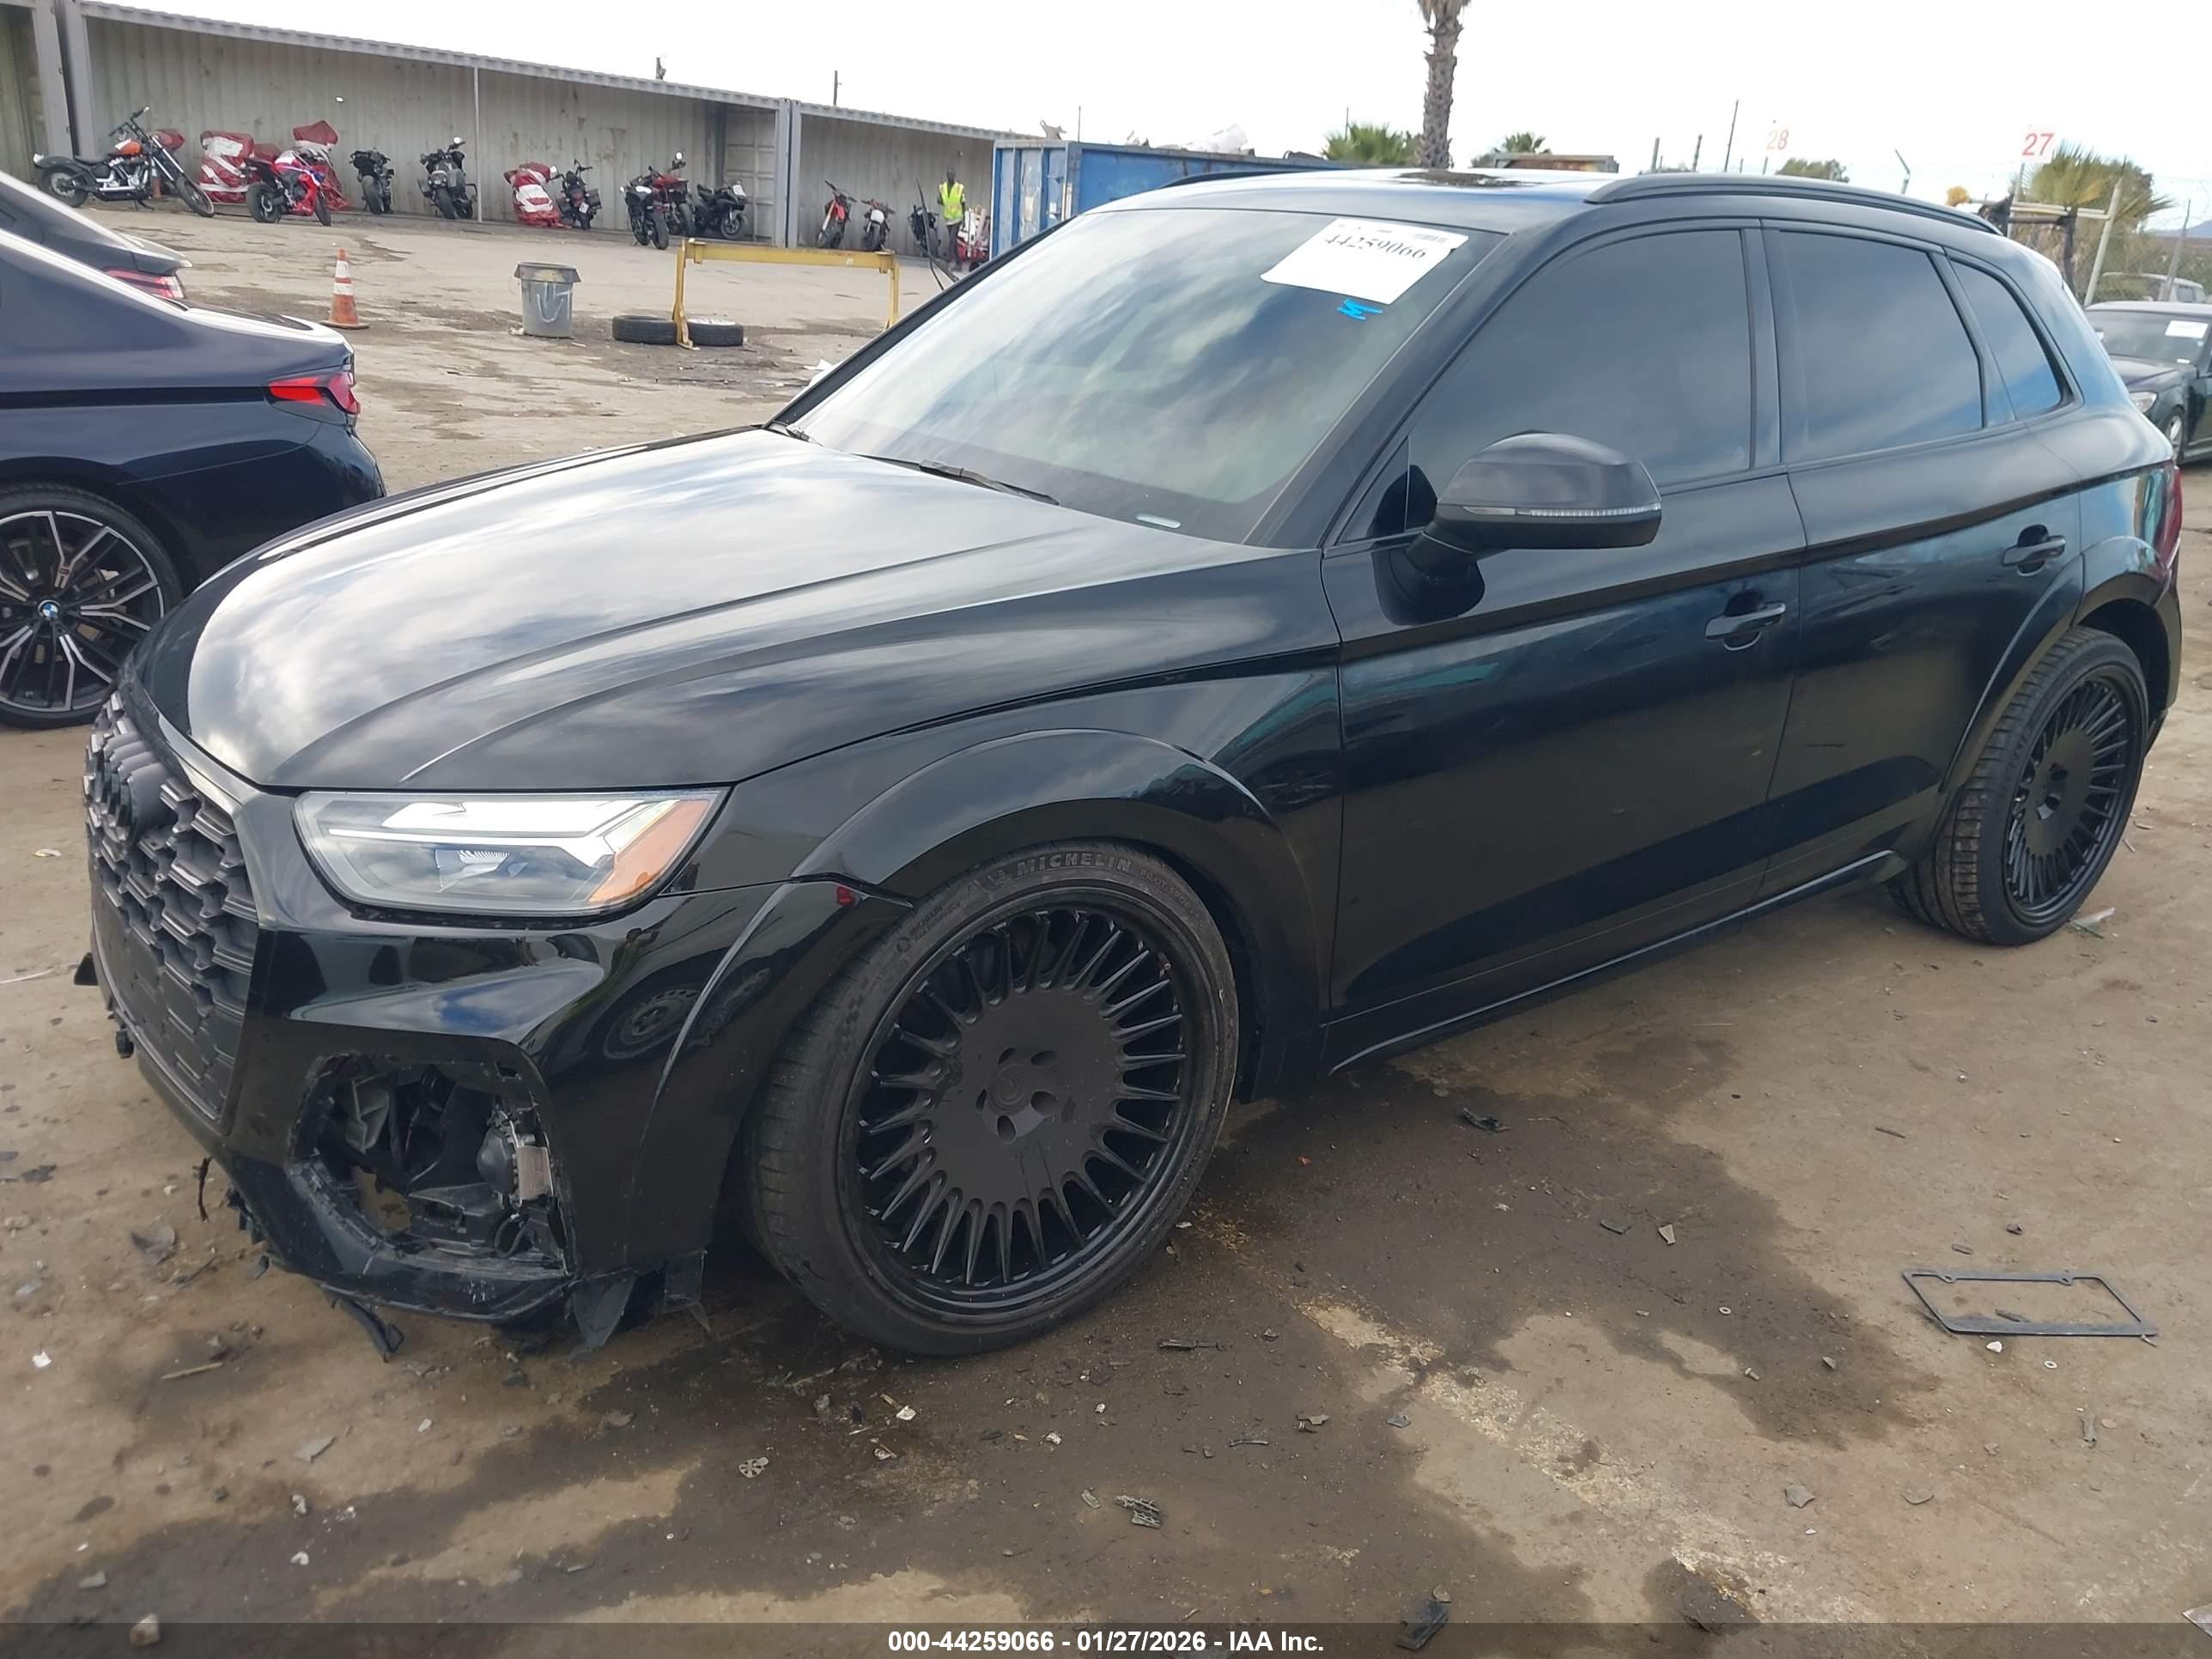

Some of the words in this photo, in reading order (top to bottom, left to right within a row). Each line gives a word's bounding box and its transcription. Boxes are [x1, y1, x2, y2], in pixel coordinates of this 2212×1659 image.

[1766, 129, 1790, 150] 28
[2021, 132, 2054, 156] 27
[1018, 853, 1132, 877] MICHELIN
[1139, 867, 1169, 888] PILOT
